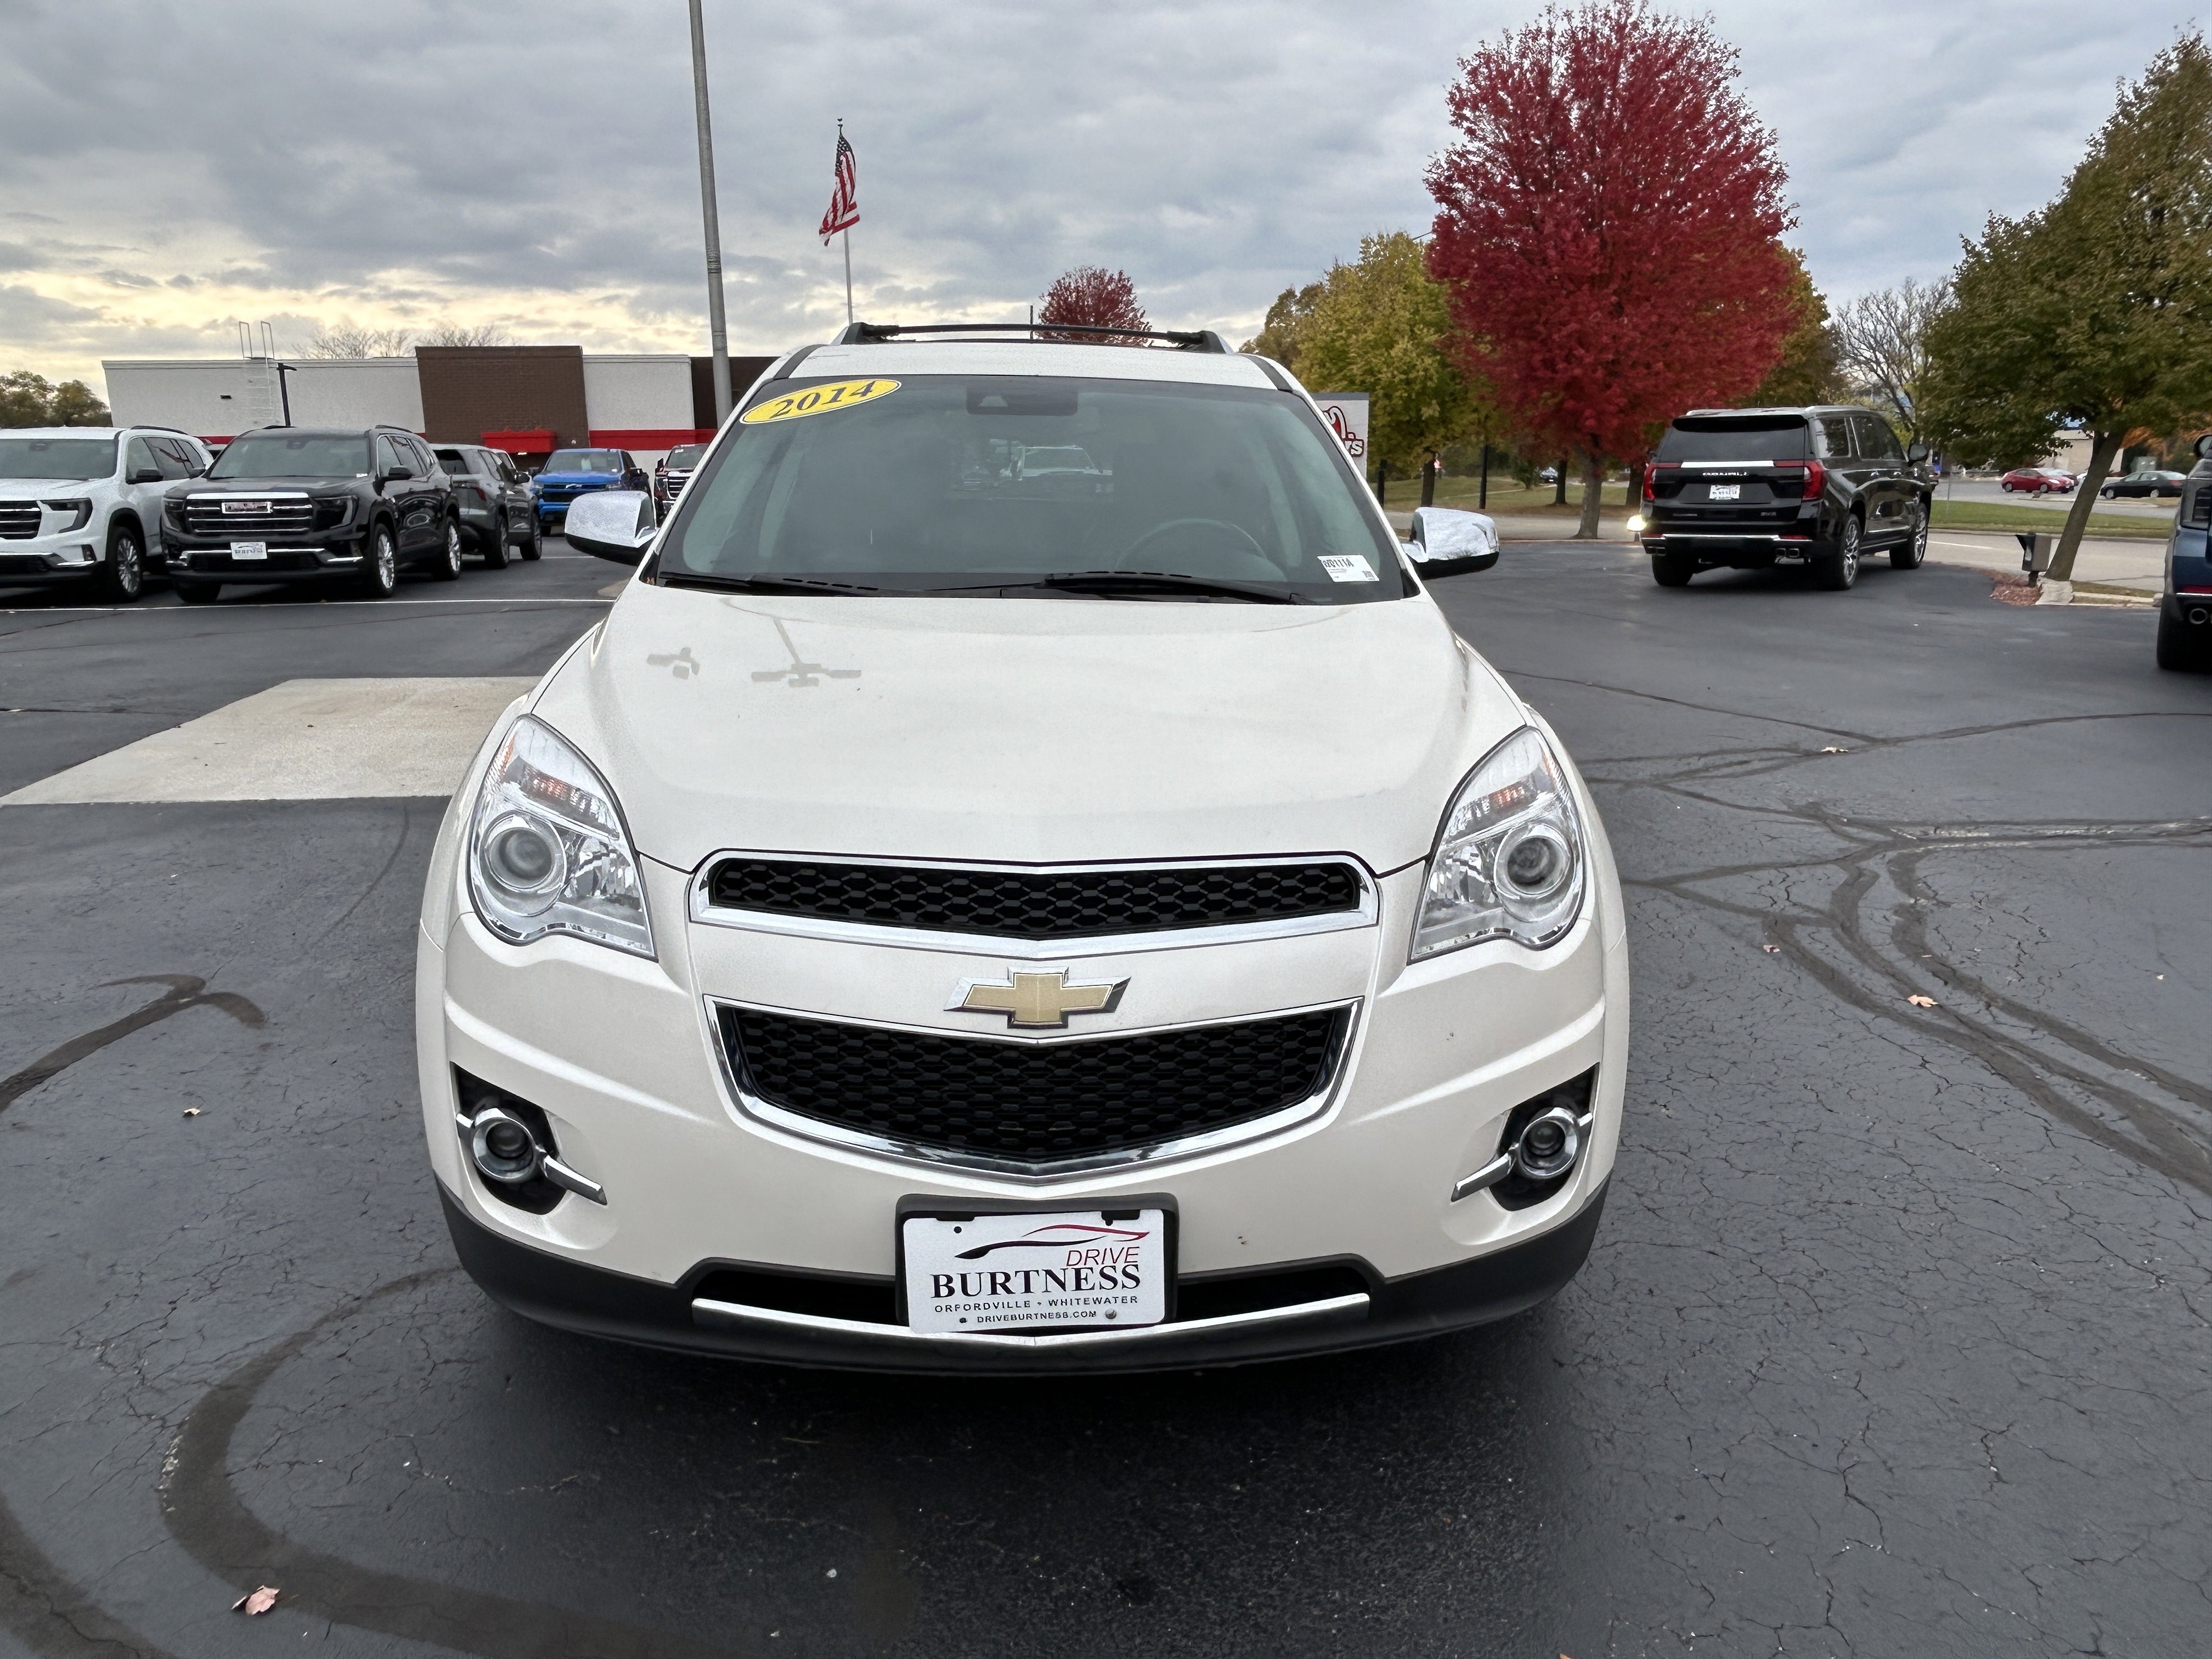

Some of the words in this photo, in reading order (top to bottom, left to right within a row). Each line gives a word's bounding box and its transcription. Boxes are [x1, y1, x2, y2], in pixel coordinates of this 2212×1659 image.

[769, 380, 876, 419] 2014
[1066, 1246, 1140, 1267] DRIVE
[930, 1263, 1141, 1299] BURTNESS
[934, 1300, 1030, 1313] ORFORDVILLE
[1048, 1296, 1138, 1307] WHITEWATER
[977, 1310, 1097, 1323] DRIVEBURTNESS.COM
